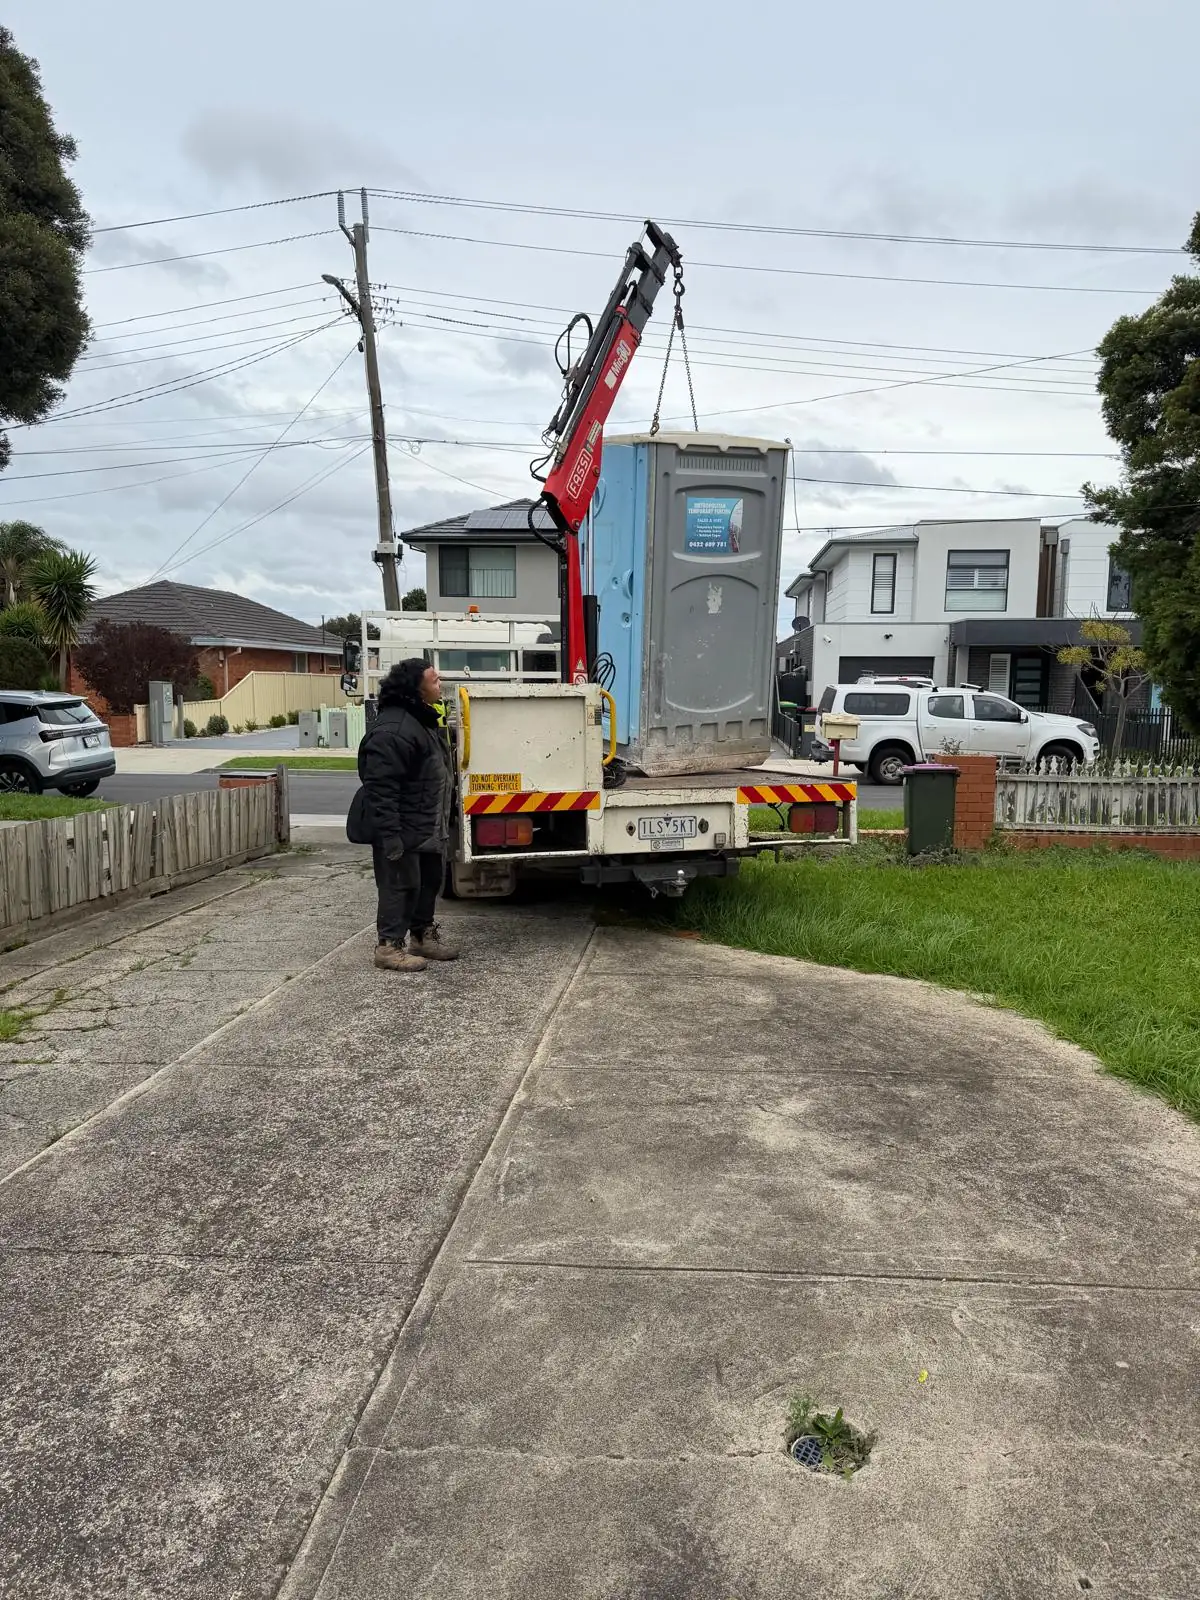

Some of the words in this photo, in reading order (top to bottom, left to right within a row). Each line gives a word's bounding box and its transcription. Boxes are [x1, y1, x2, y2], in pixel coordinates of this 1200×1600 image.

[569, 454, 590, 495] FASSI
[471, 774, 479, 783] DO
[481, 774, 491, 783] NOT
[493, 773, 519, 783] OVERTAKE
[471, 783, 495, 791] TURNING
[497, 782, 519, 791] VEHICLE
